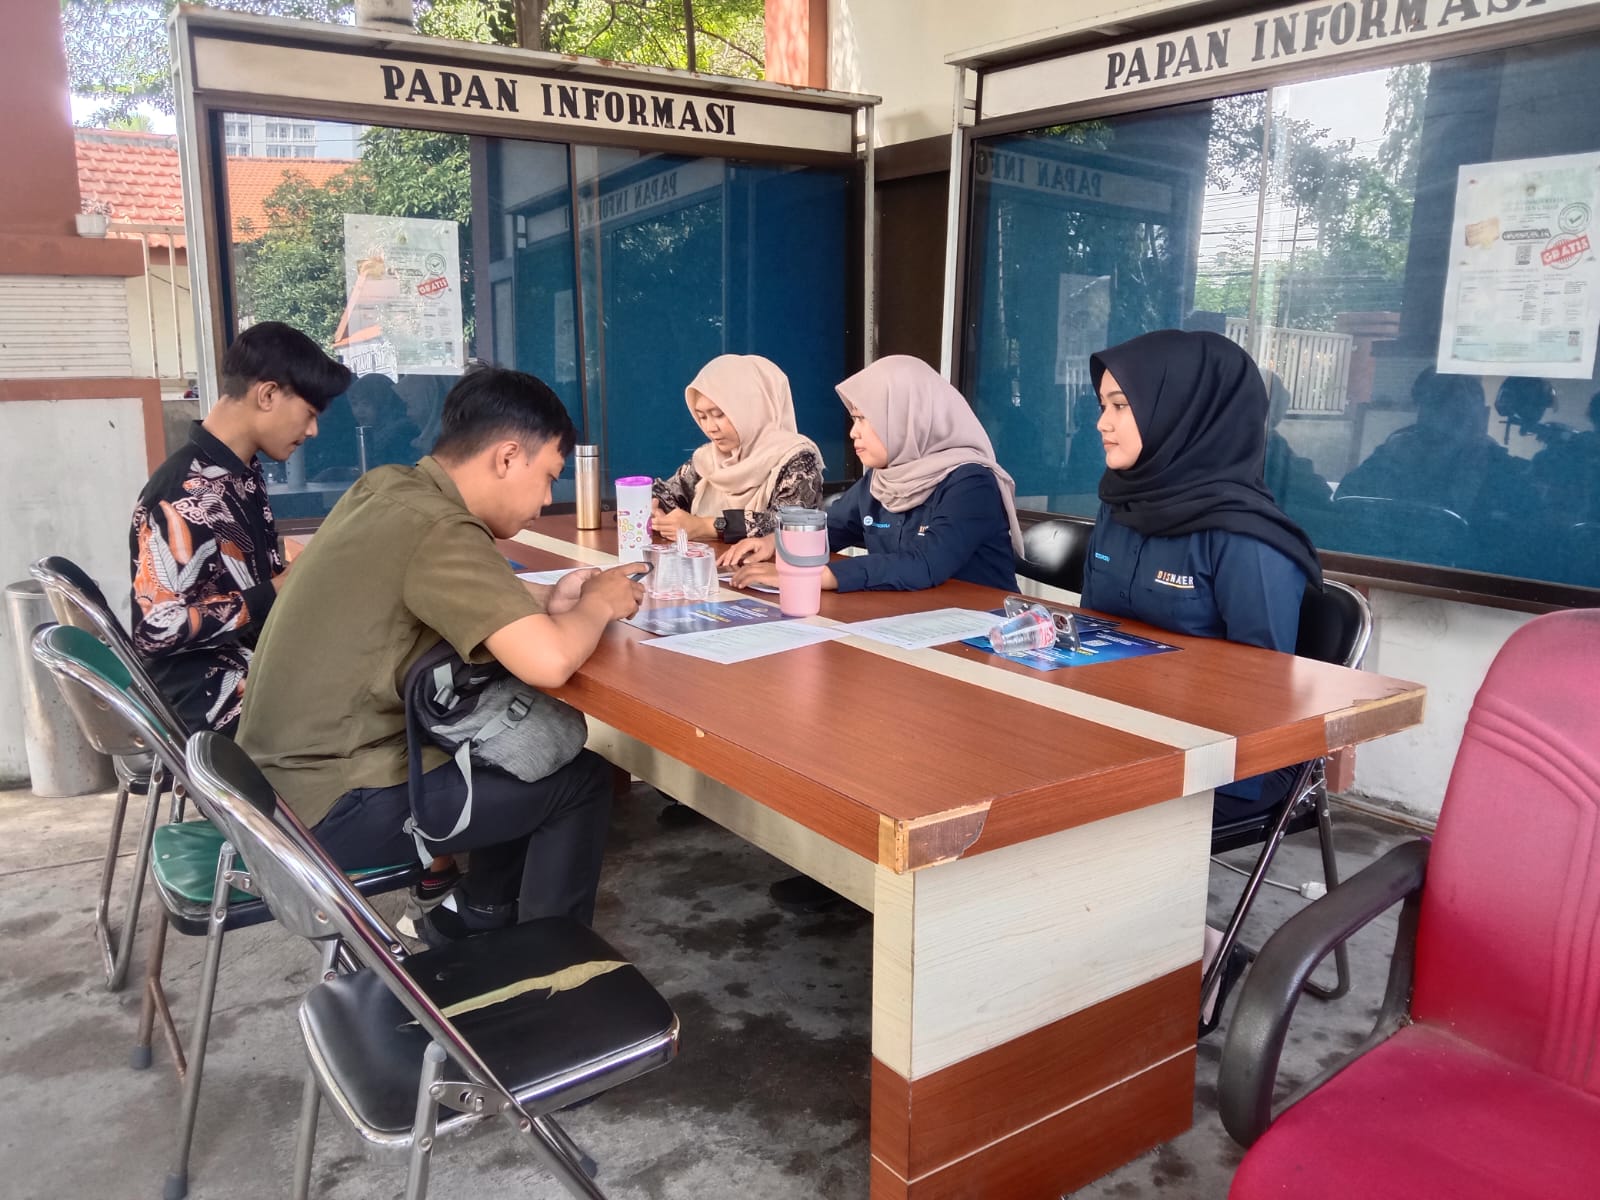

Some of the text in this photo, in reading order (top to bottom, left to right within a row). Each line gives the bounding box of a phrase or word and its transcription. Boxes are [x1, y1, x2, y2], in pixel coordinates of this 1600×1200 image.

[1105, 0, 1548, 90] PAPAN INFORMA
[380, 65, 735, 135] PAPAN INFORMASI
[1543, 237, 1588, 265] GRATIS
